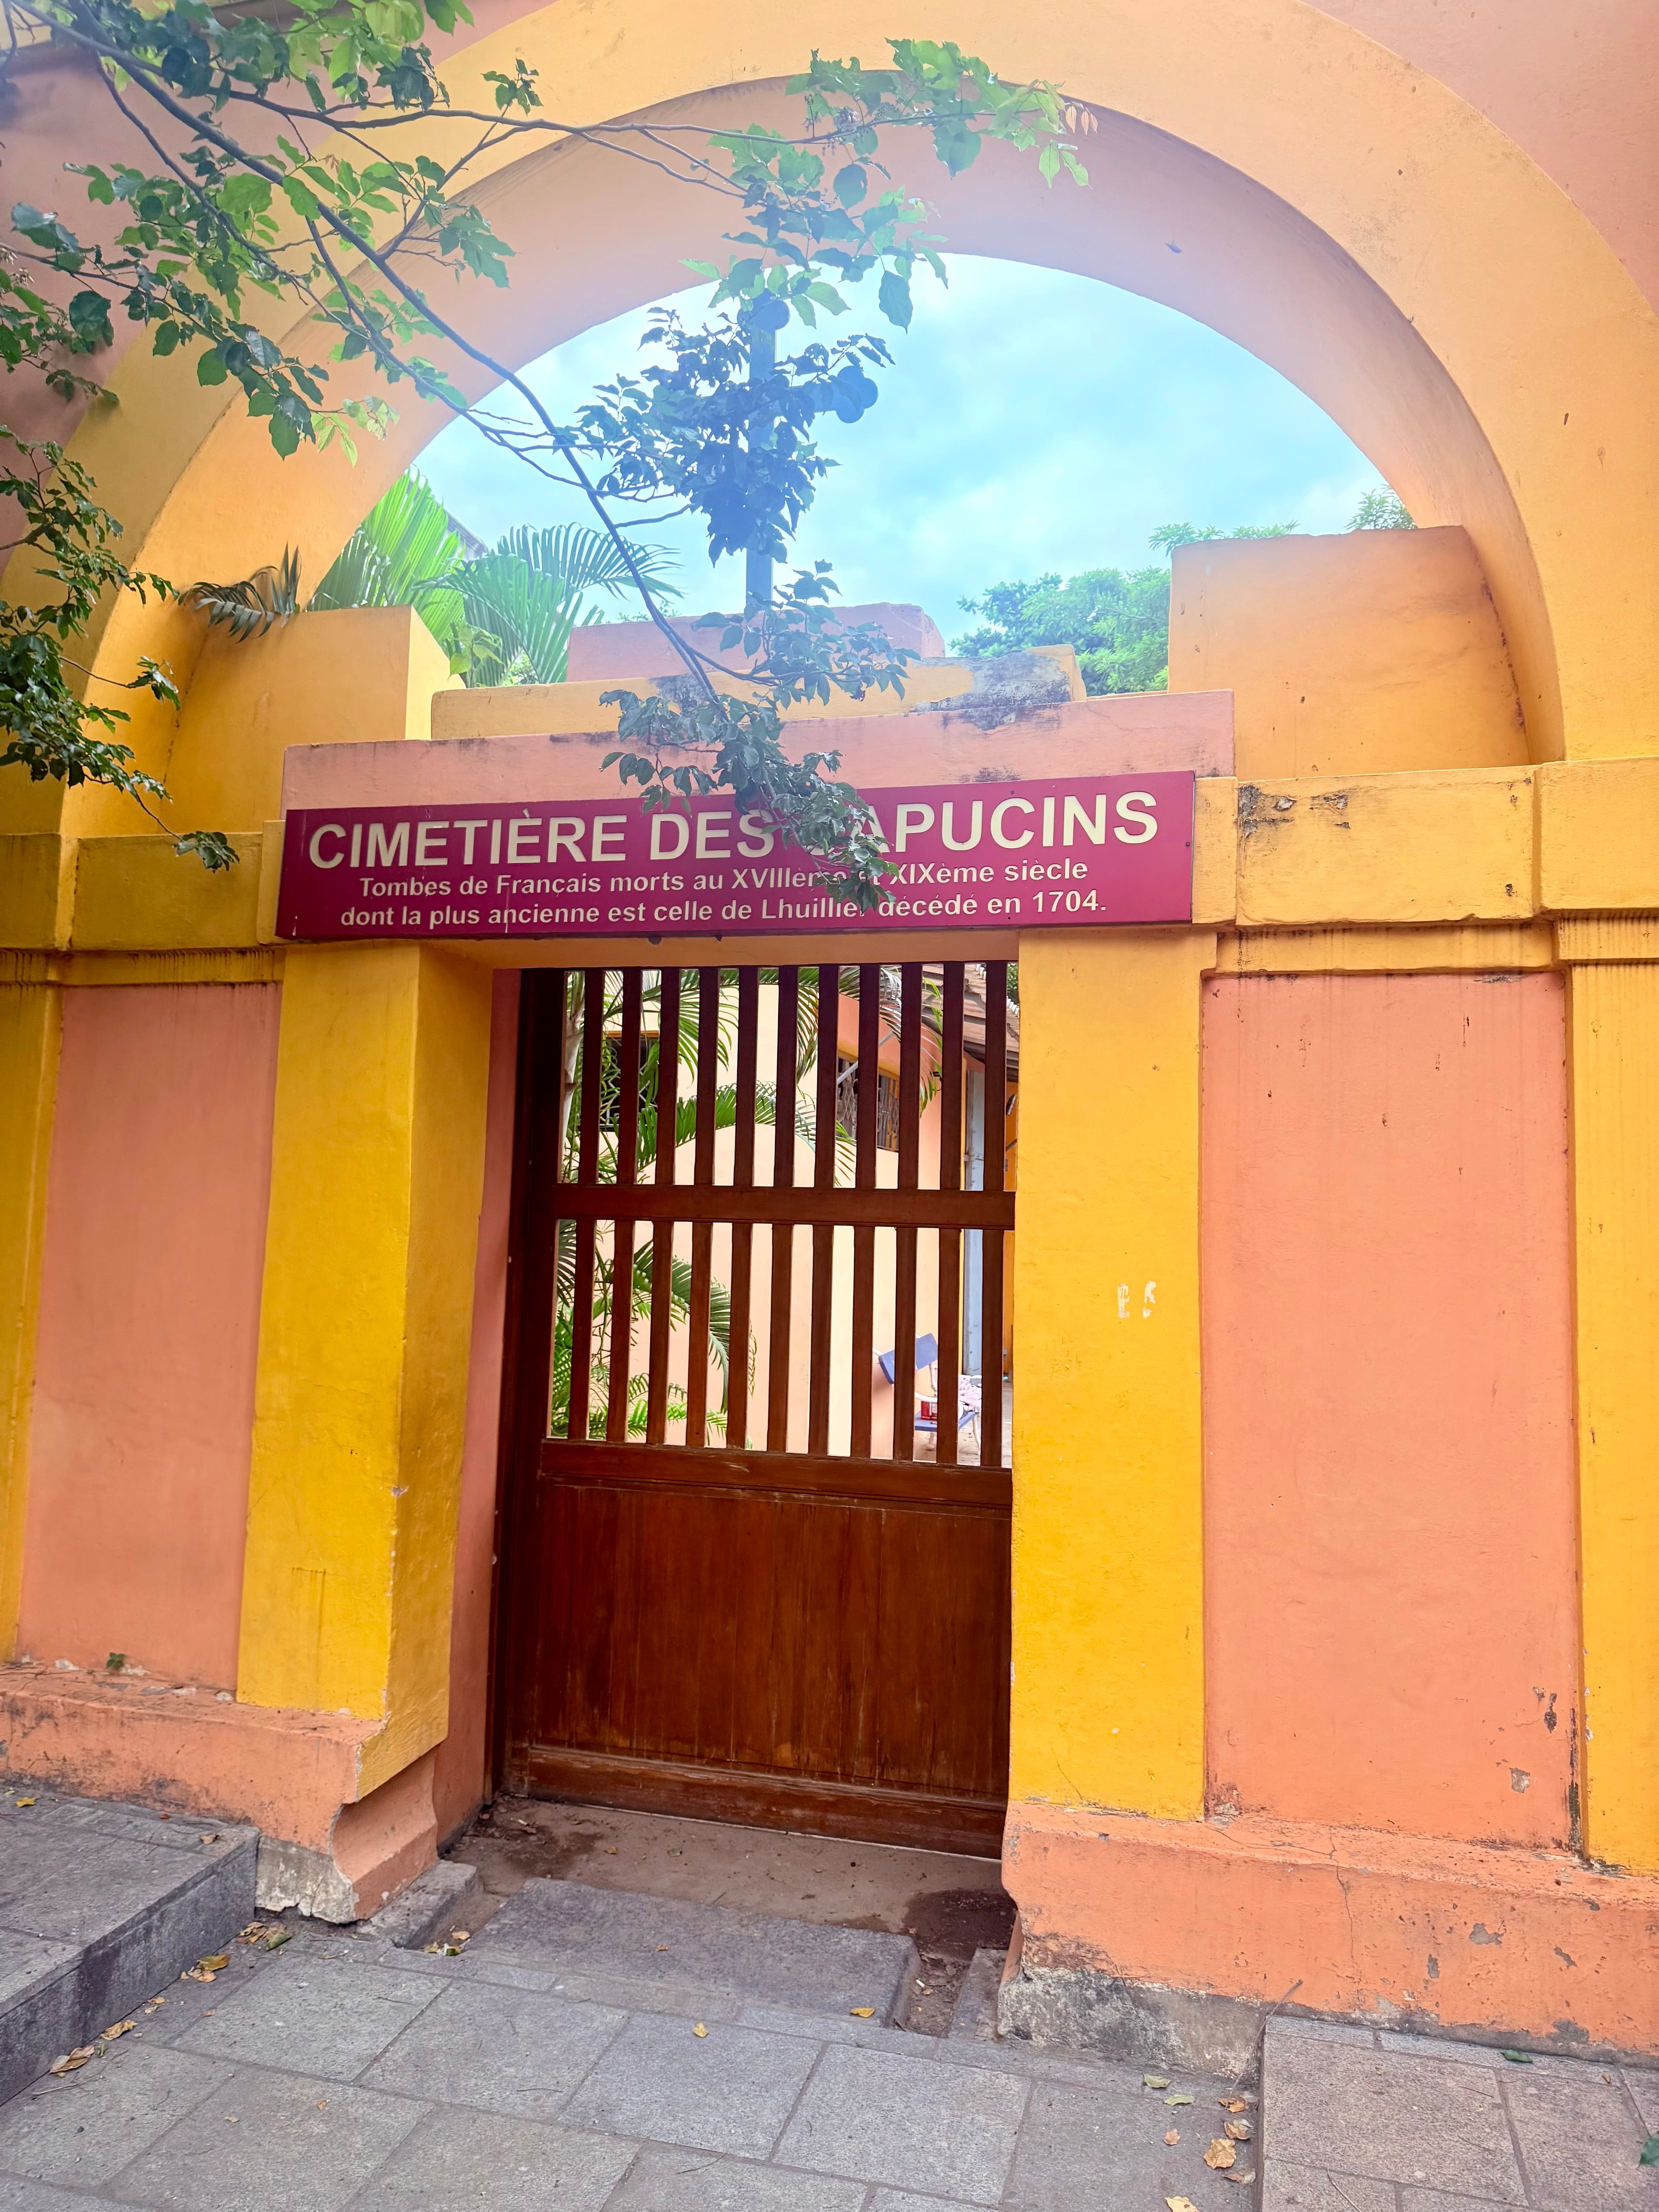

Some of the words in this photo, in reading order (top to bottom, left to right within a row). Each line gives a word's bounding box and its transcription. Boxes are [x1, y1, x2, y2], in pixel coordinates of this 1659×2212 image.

[308, 808, 627, 869] CIMETIÈRE
[649, 809, 775, 861] DES
[800, 791, 1159, 856] APUCINS
[360, 876, 451, 897] Tombes
[459, 875, 488, 896] de
[497, 872, 601, 897] Français
[610, 871, 684, 892] morts
[693, 874, 723, 890] au
[889, 862, 995, 885] XIXème
[1004, 857, 1088, 882] siècle
[340, 906, 394, 926] dont
[402, 906, 421, 925] la
[429, 905, 480, 930] plus
[488, 903, 600, 924] ancienne
[608, 902, 646, 922] est
[654, 900, 713, 922] celle
[721, 899, 752, 920] de
[761, 896, 866, 919] Lhuillie
[878, 893, 978, 917] décédé
[987, 898, 1021, 915] en
[1032, 889, 1107, 913] 1704.
